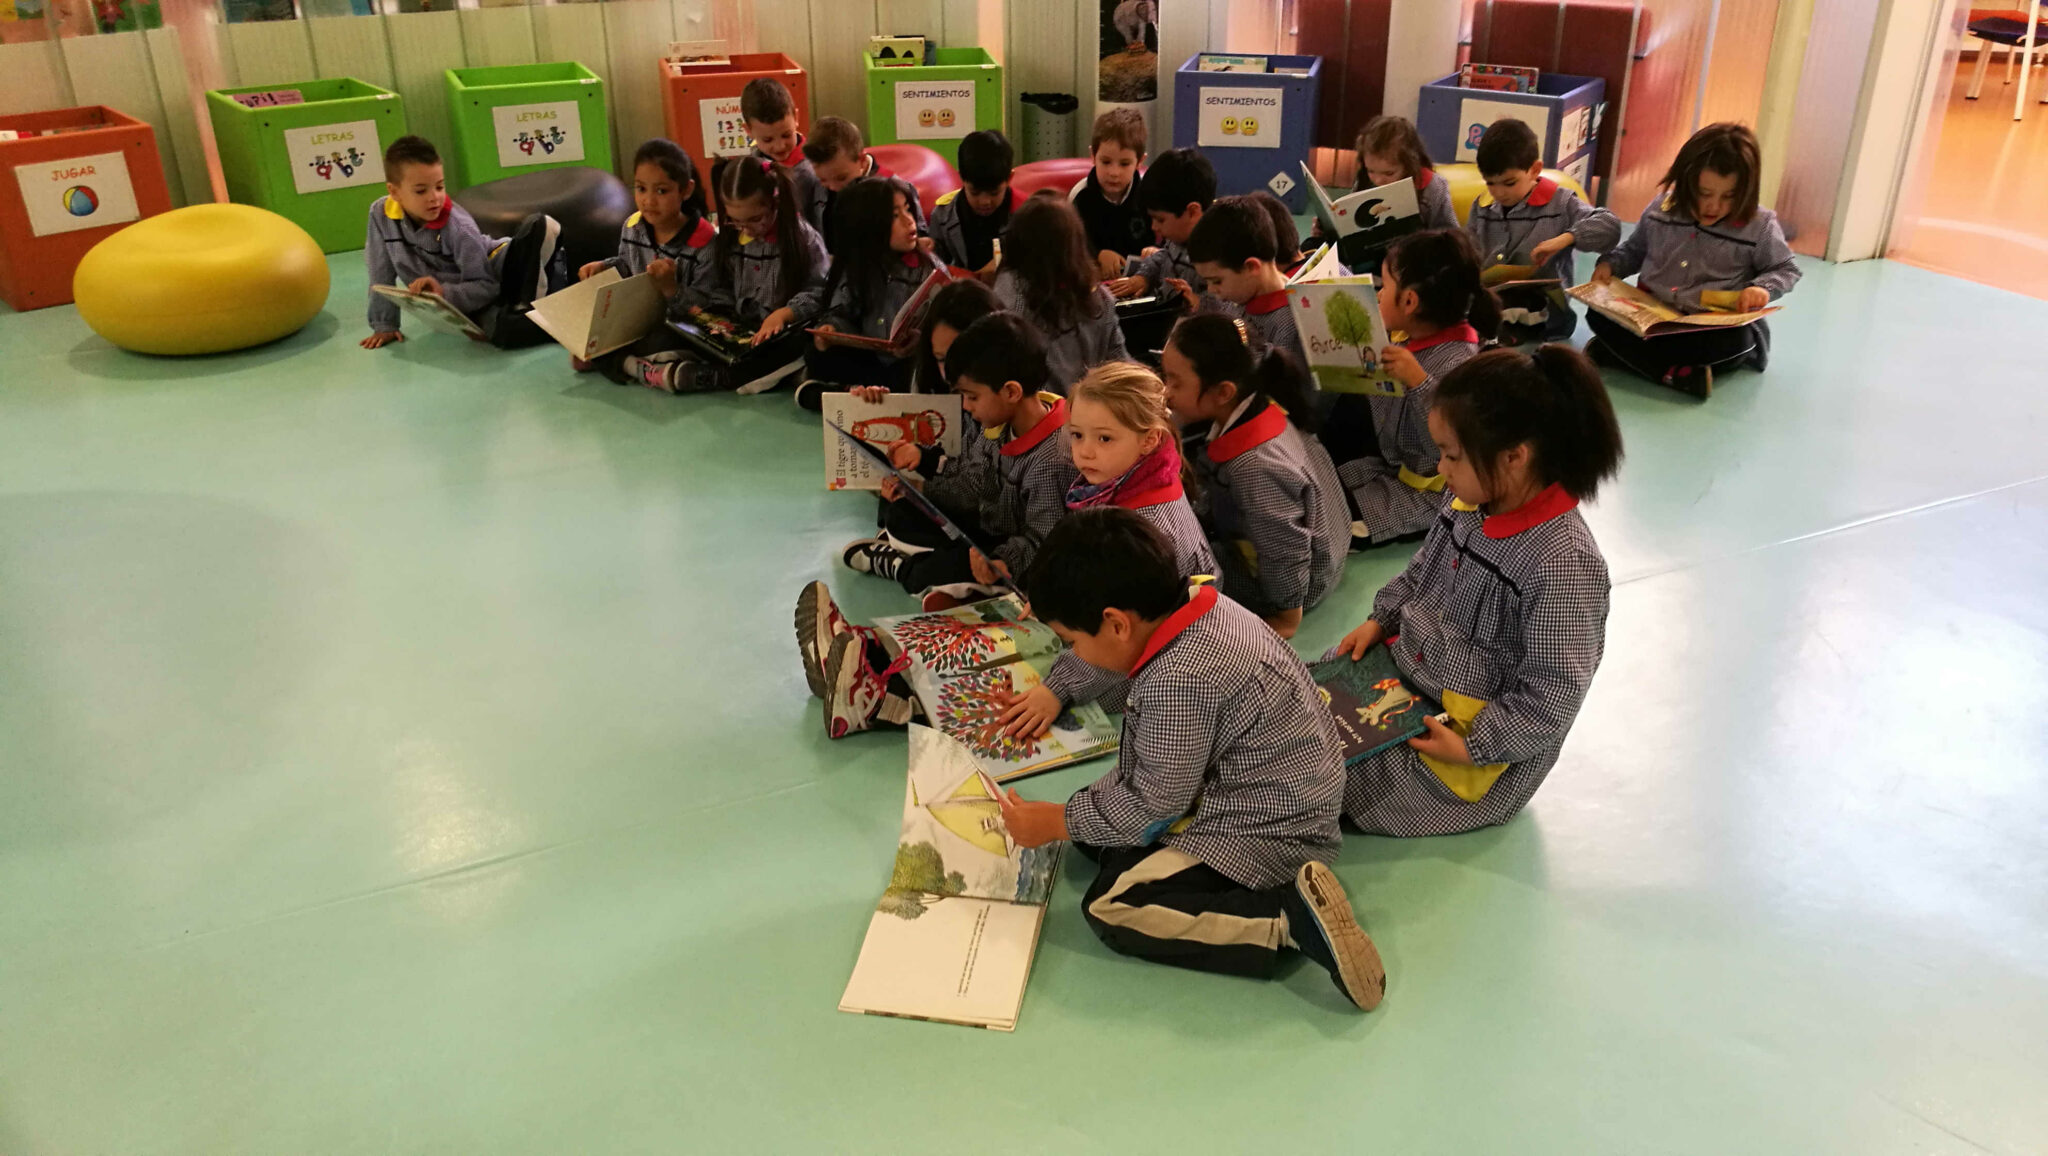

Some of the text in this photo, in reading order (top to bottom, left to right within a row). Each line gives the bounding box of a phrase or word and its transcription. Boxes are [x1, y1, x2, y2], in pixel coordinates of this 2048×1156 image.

[902, 90, 971, 99] SENTIMIENTOS
[1205, 96, 1277, 106] SENTIMIENTOS
[715, 102, 742, 115] NÚM
[515, 110, 557, 122] LETRAS
[310, 132, 355, 145] LETRAS
[51, 165, 96, 182] JUGAR
[1276, 180, 1288, 190] 17
[838, 448, 848, 467] tigre
[836, 469, 846, 477] El
[860, 470, 869, 478] el
